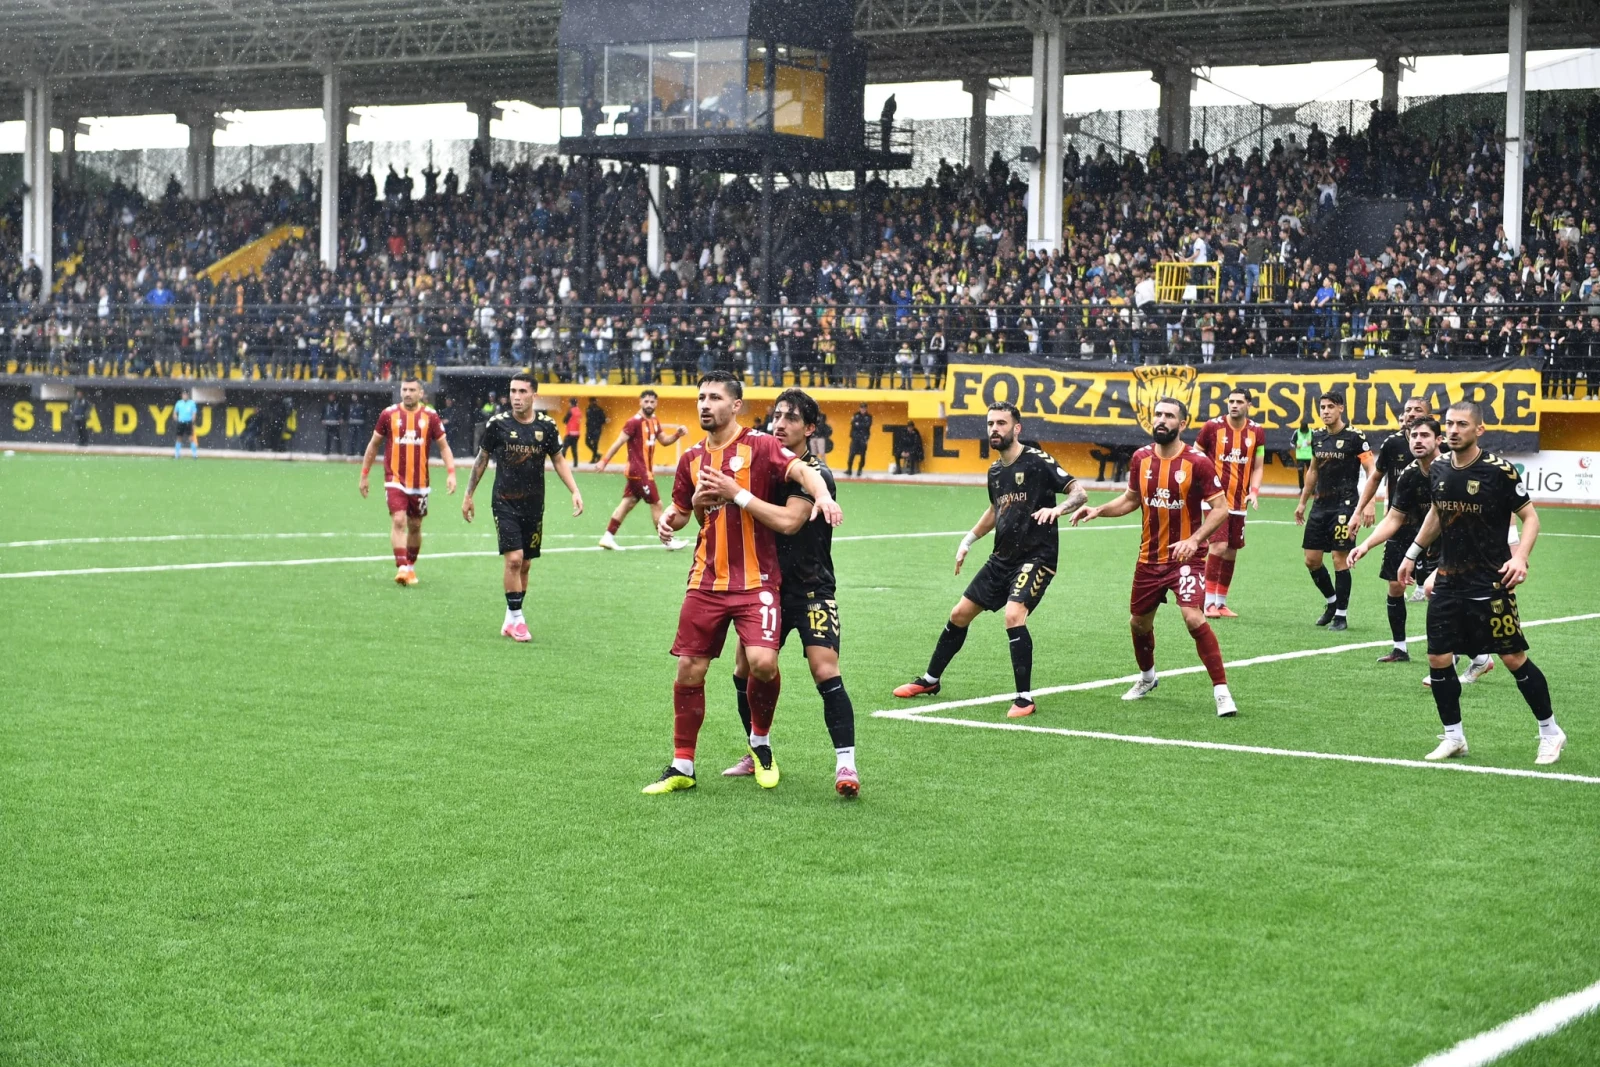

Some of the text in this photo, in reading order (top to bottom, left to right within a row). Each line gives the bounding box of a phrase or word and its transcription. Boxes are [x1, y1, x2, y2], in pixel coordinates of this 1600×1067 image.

[1142, 366, 1188, 380] FORZA
[950, 371, 1139, 419] FORZA
[1526, 467, 1563, 492] LİG
[1334, 525, 1350, 540] 25
[1015, 572, 1029, 589] 9
[1179, 575, 1197, 595] 22
[758, 606, 777, 631] 11
[807, 610, 829, 631] 12
[1490, 614, 1516, 638] 28
